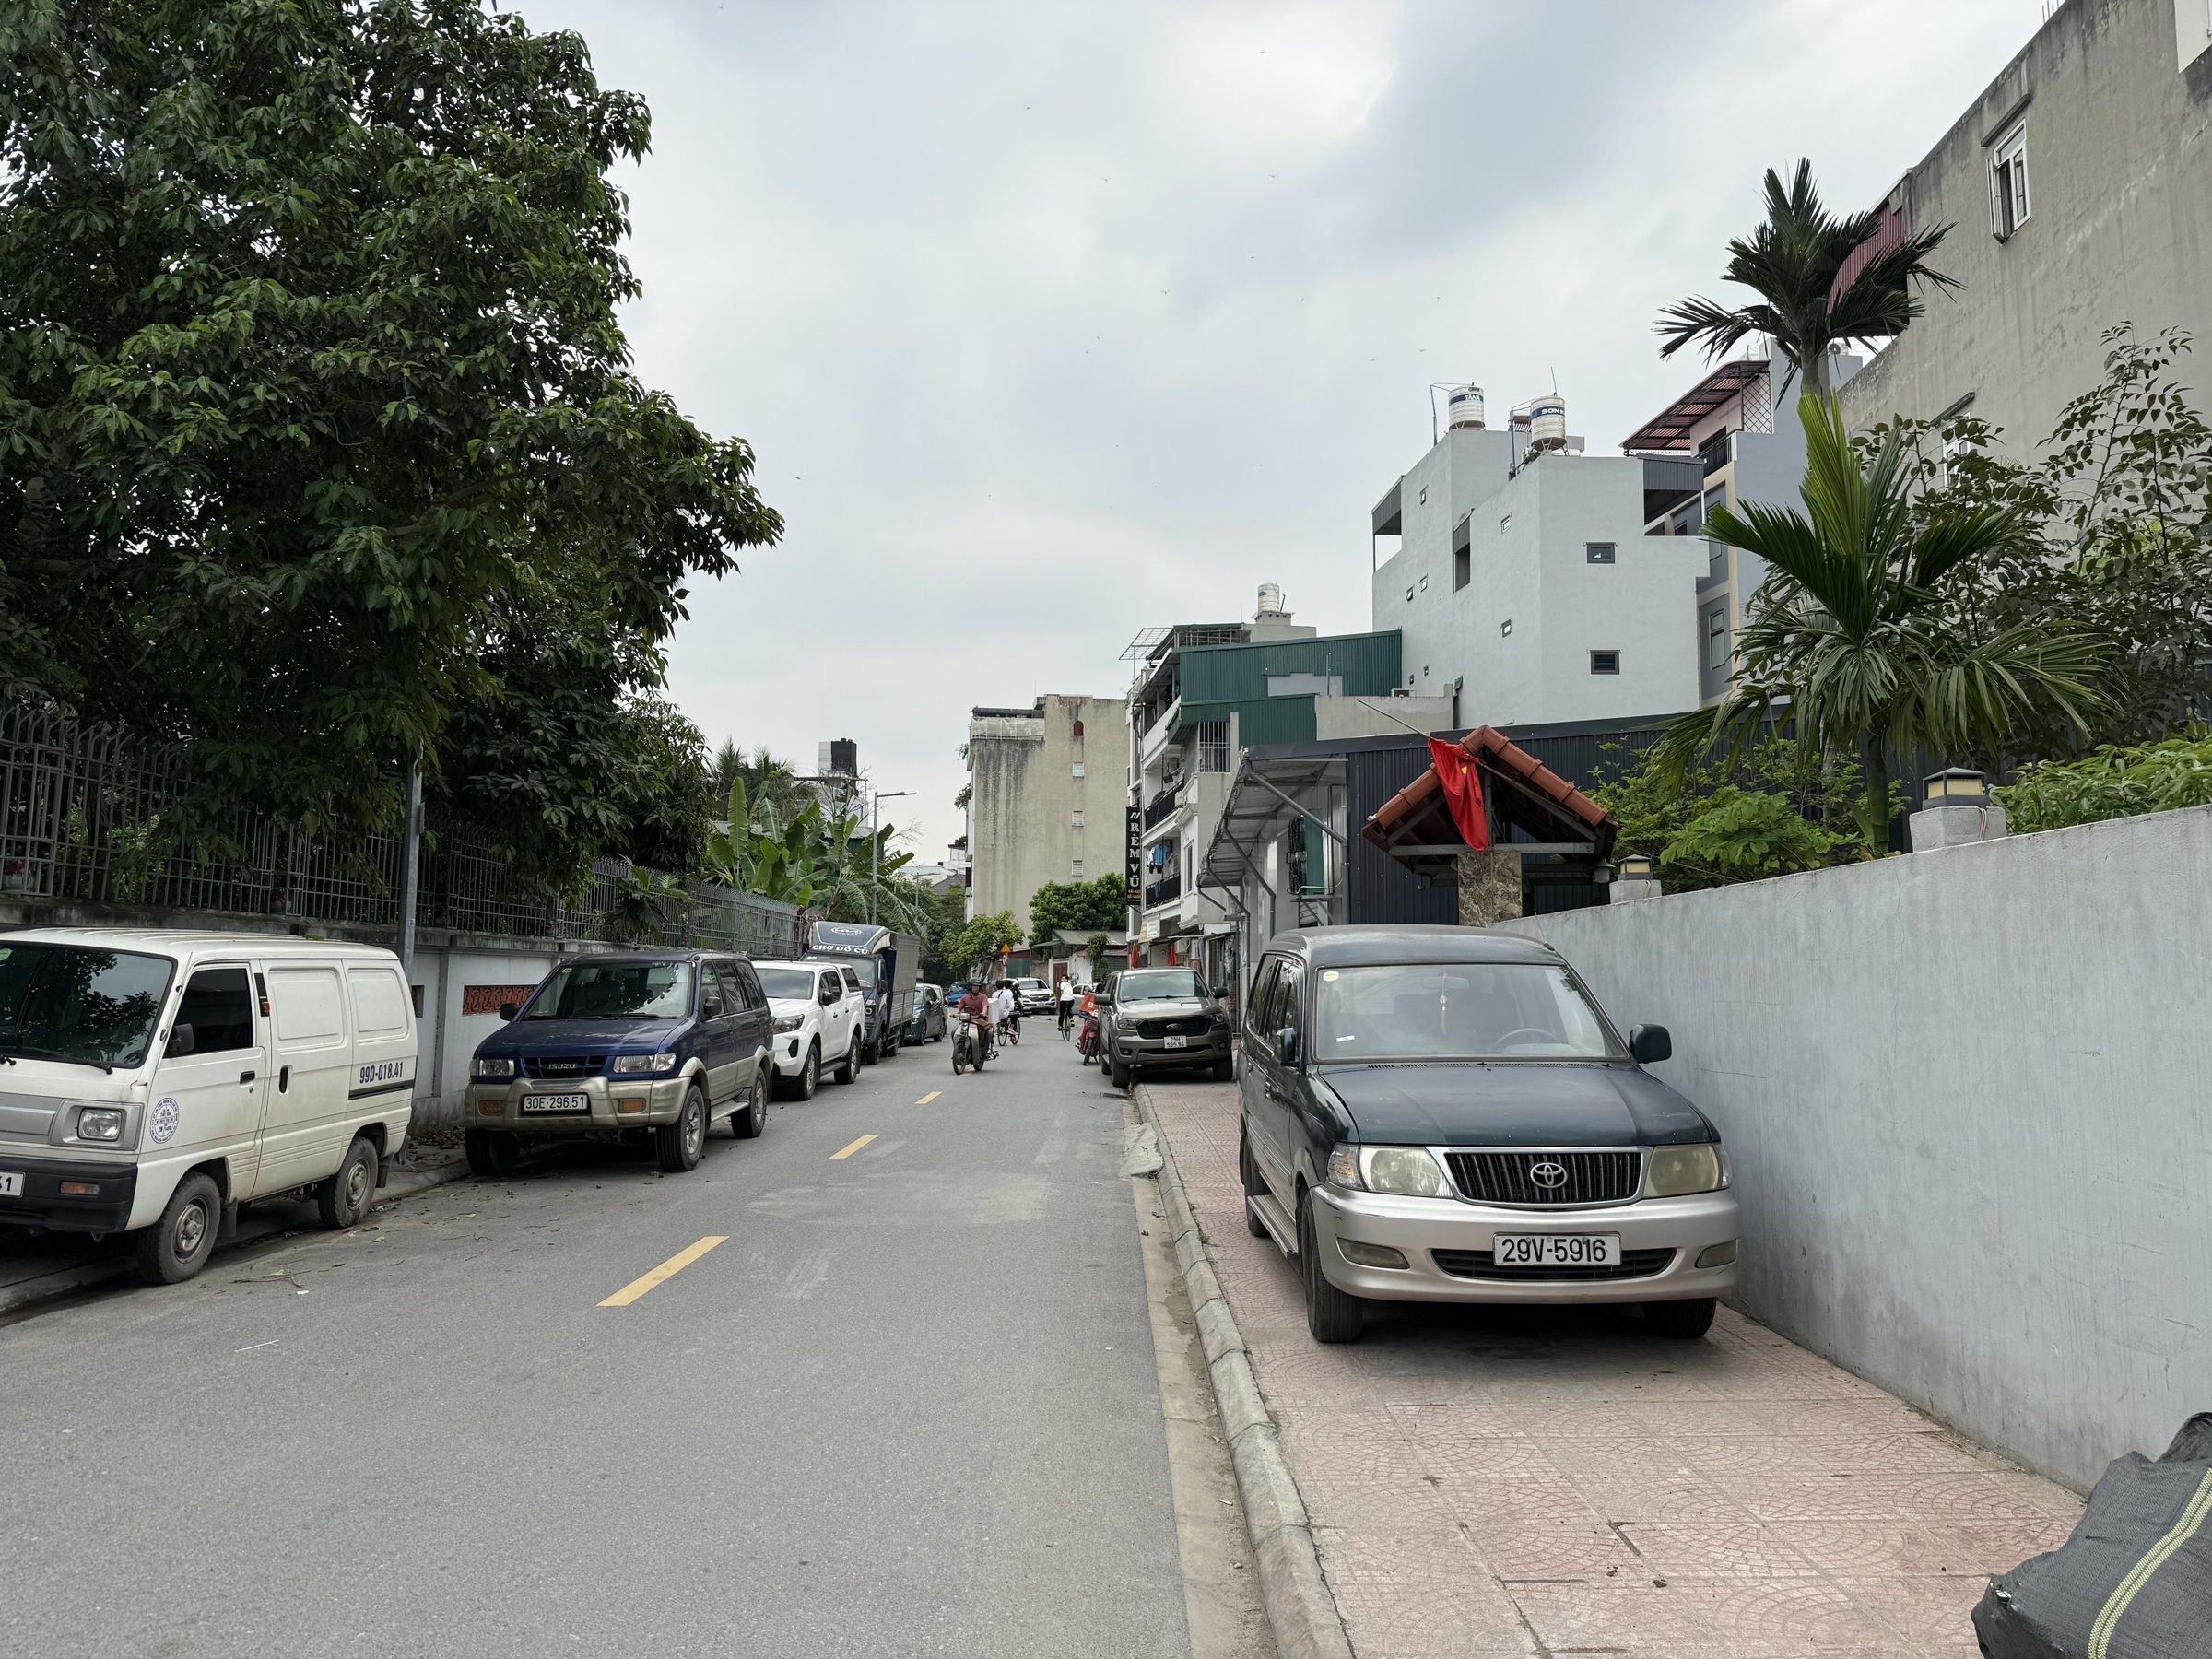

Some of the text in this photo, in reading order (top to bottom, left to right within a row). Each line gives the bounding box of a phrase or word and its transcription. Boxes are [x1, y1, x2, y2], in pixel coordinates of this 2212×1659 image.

[359, 1061, 403, 1084] 99D-018.41
[525, 1096, 584, 1109] 30E-296.51
[1501, 1238, 1606, 1262] 29V-5916
